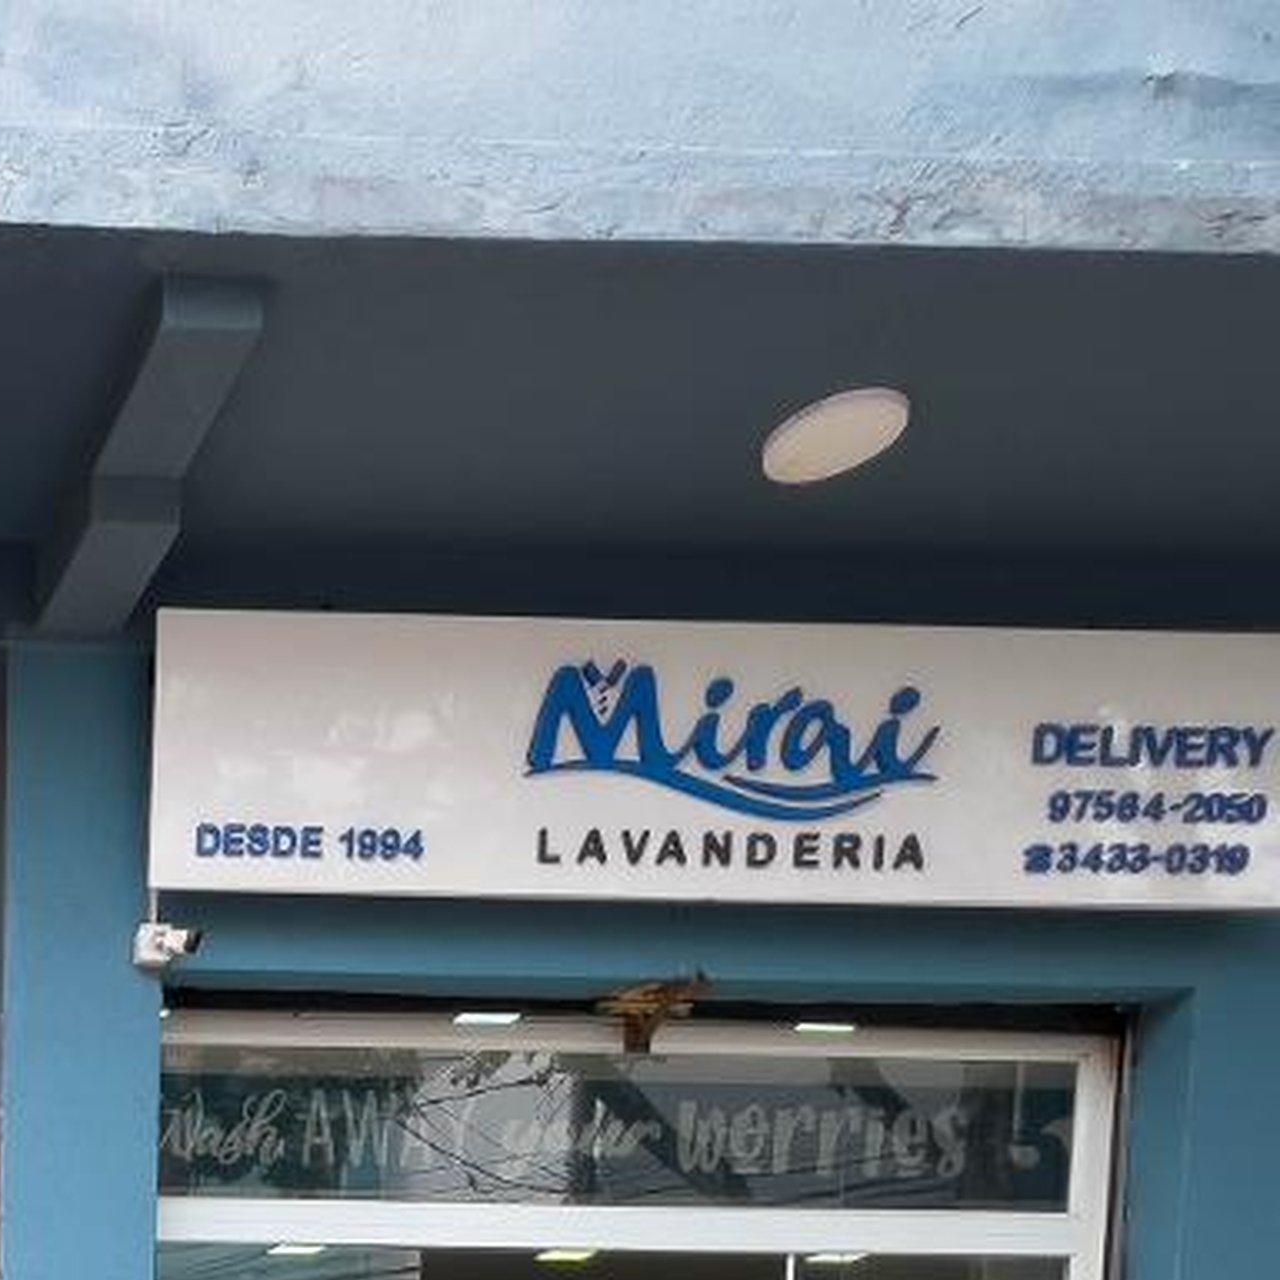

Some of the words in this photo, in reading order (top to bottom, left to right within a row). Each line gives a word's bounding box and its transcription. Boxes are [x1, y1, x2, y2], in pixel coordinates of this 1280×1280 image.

[526, 659, 940, 795] Mirai
[1031, 722, 1275, 768] DELIVERY
[196, 821, 325, 858] DESDE
[338, 826, 425, 861] 1994
[537, 827, 926, 871] LAVANDERIA
